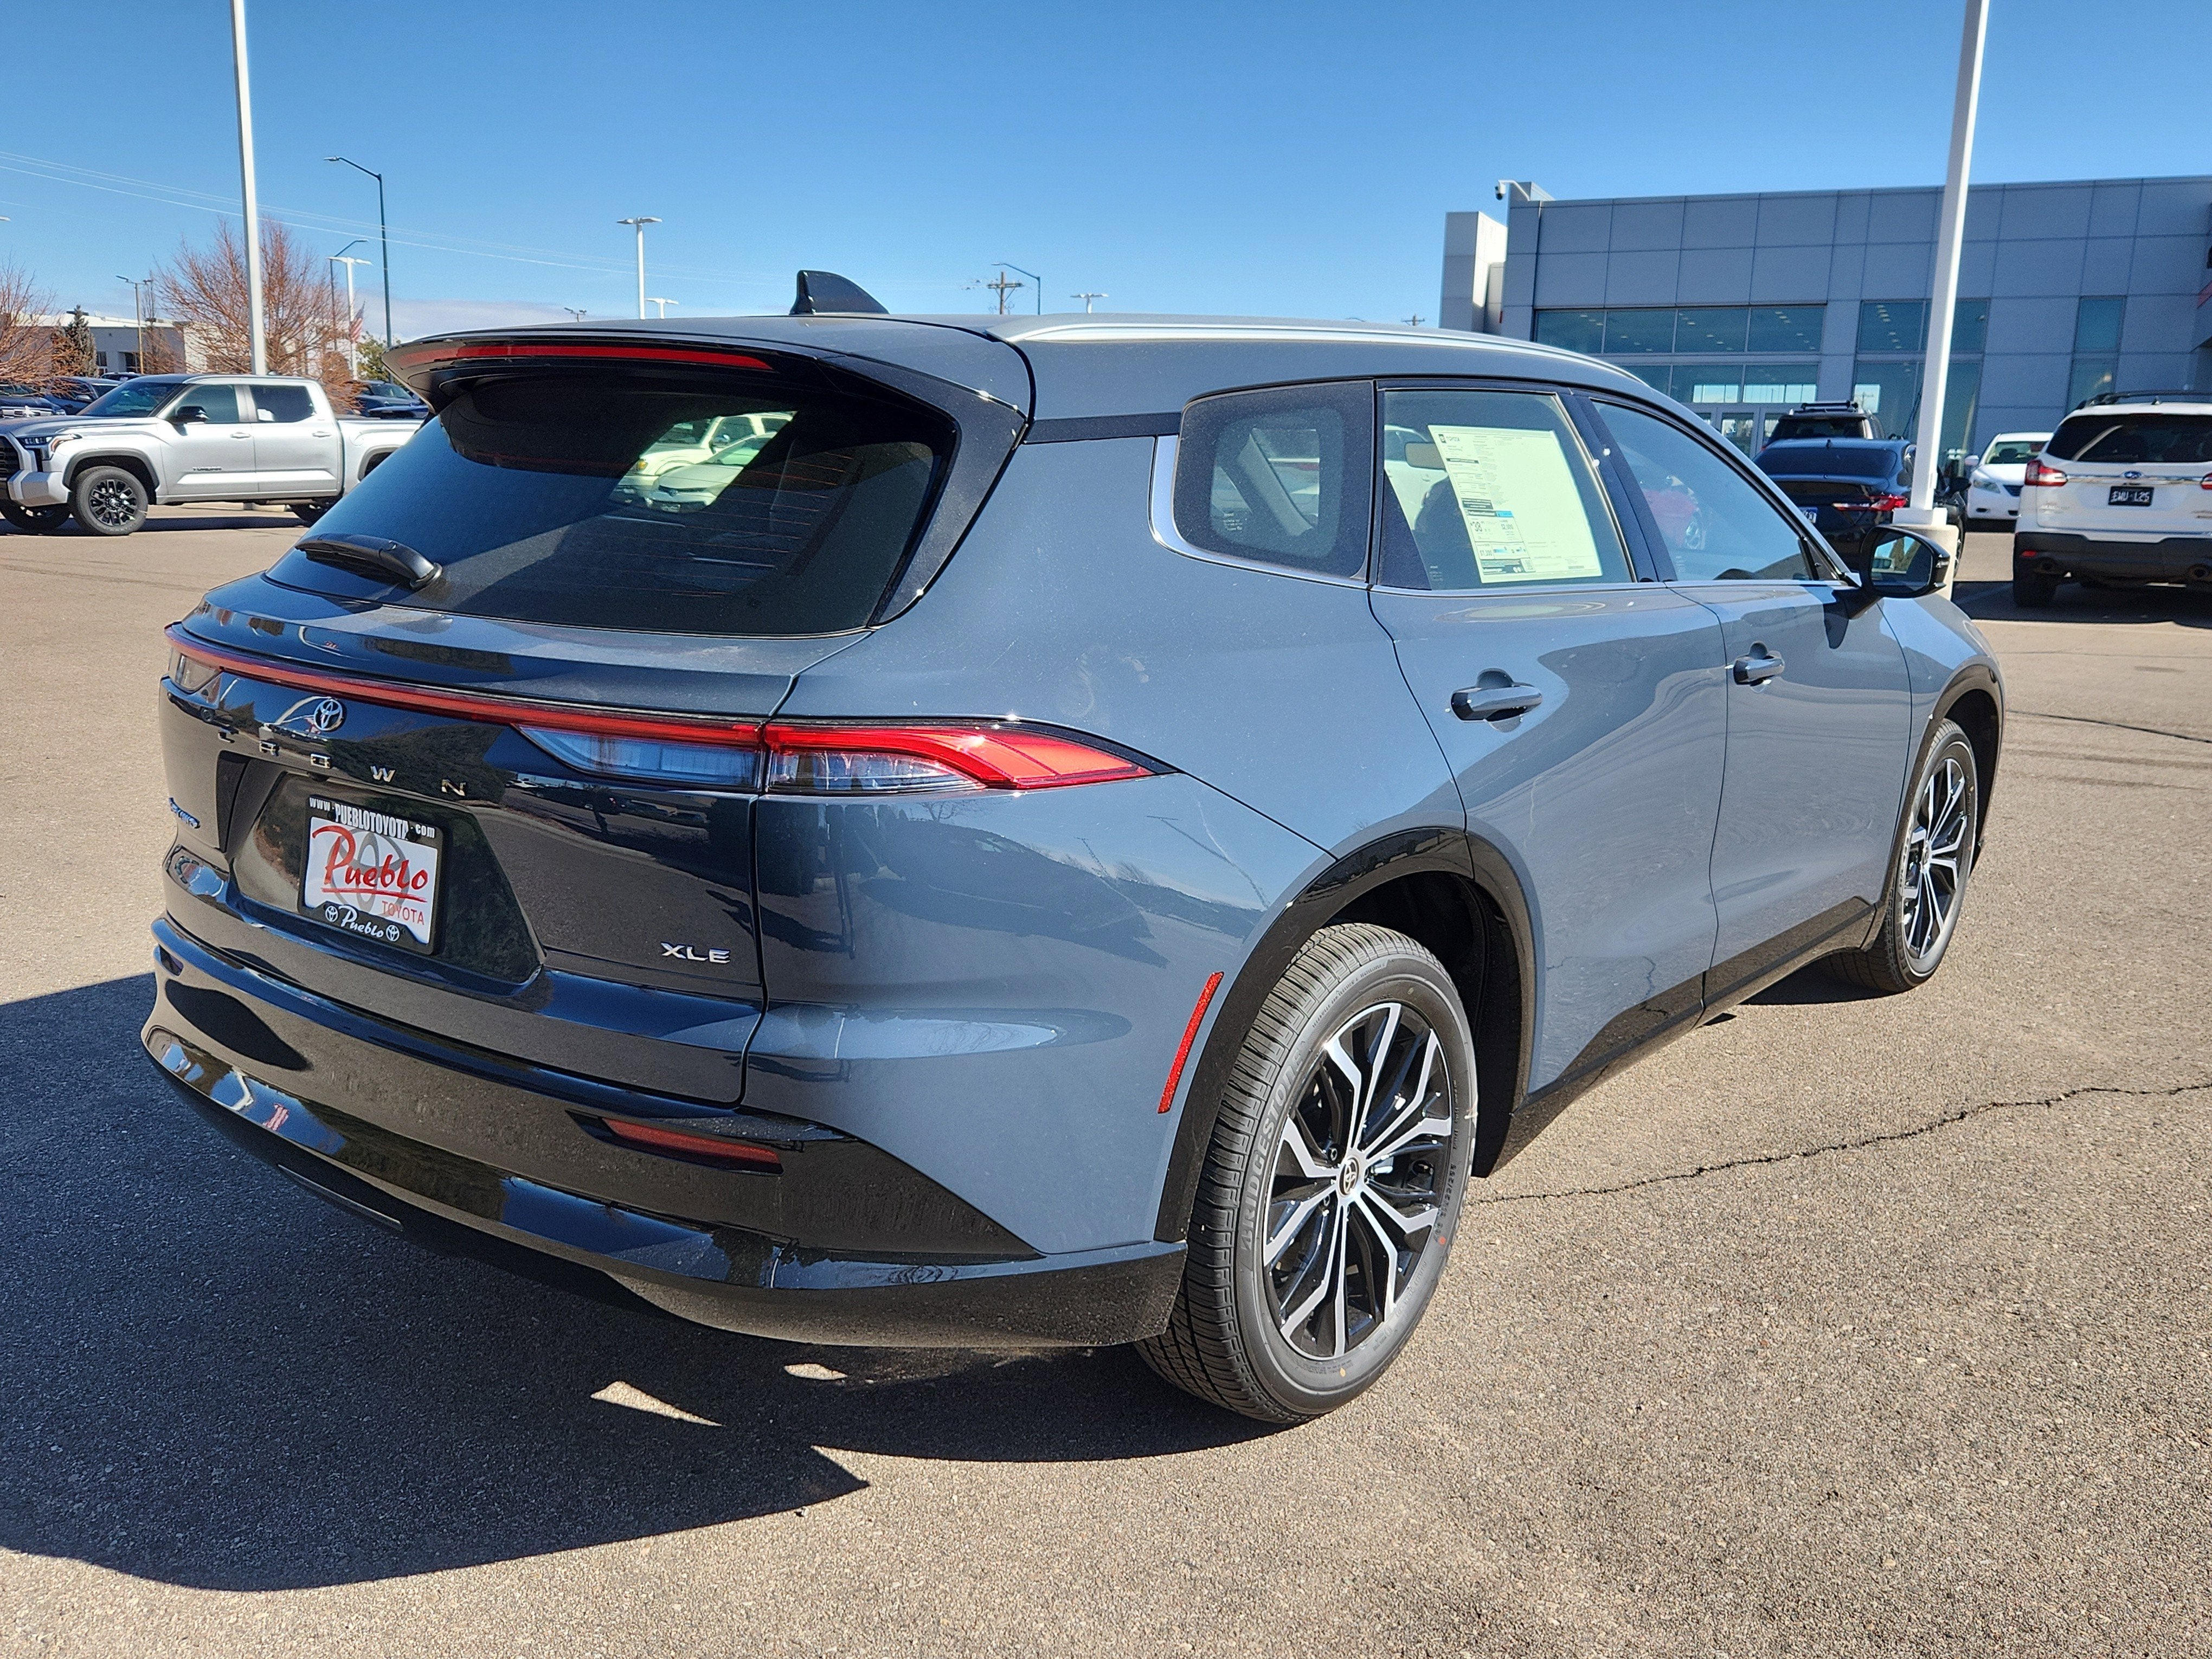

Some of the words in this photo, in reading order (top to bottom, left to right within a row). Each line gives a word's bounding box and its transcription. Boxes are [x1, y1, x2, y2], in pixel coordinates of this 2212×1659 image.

[312, 825, 428, 890] Pueblo
[338, 904, 384, 938] Pueblo
[381, 900, 425, 925] TOYOTA
[660, 941, 731, 963] XLE
[1240, 1050, 1304, 1250] BRIDGESTONE
